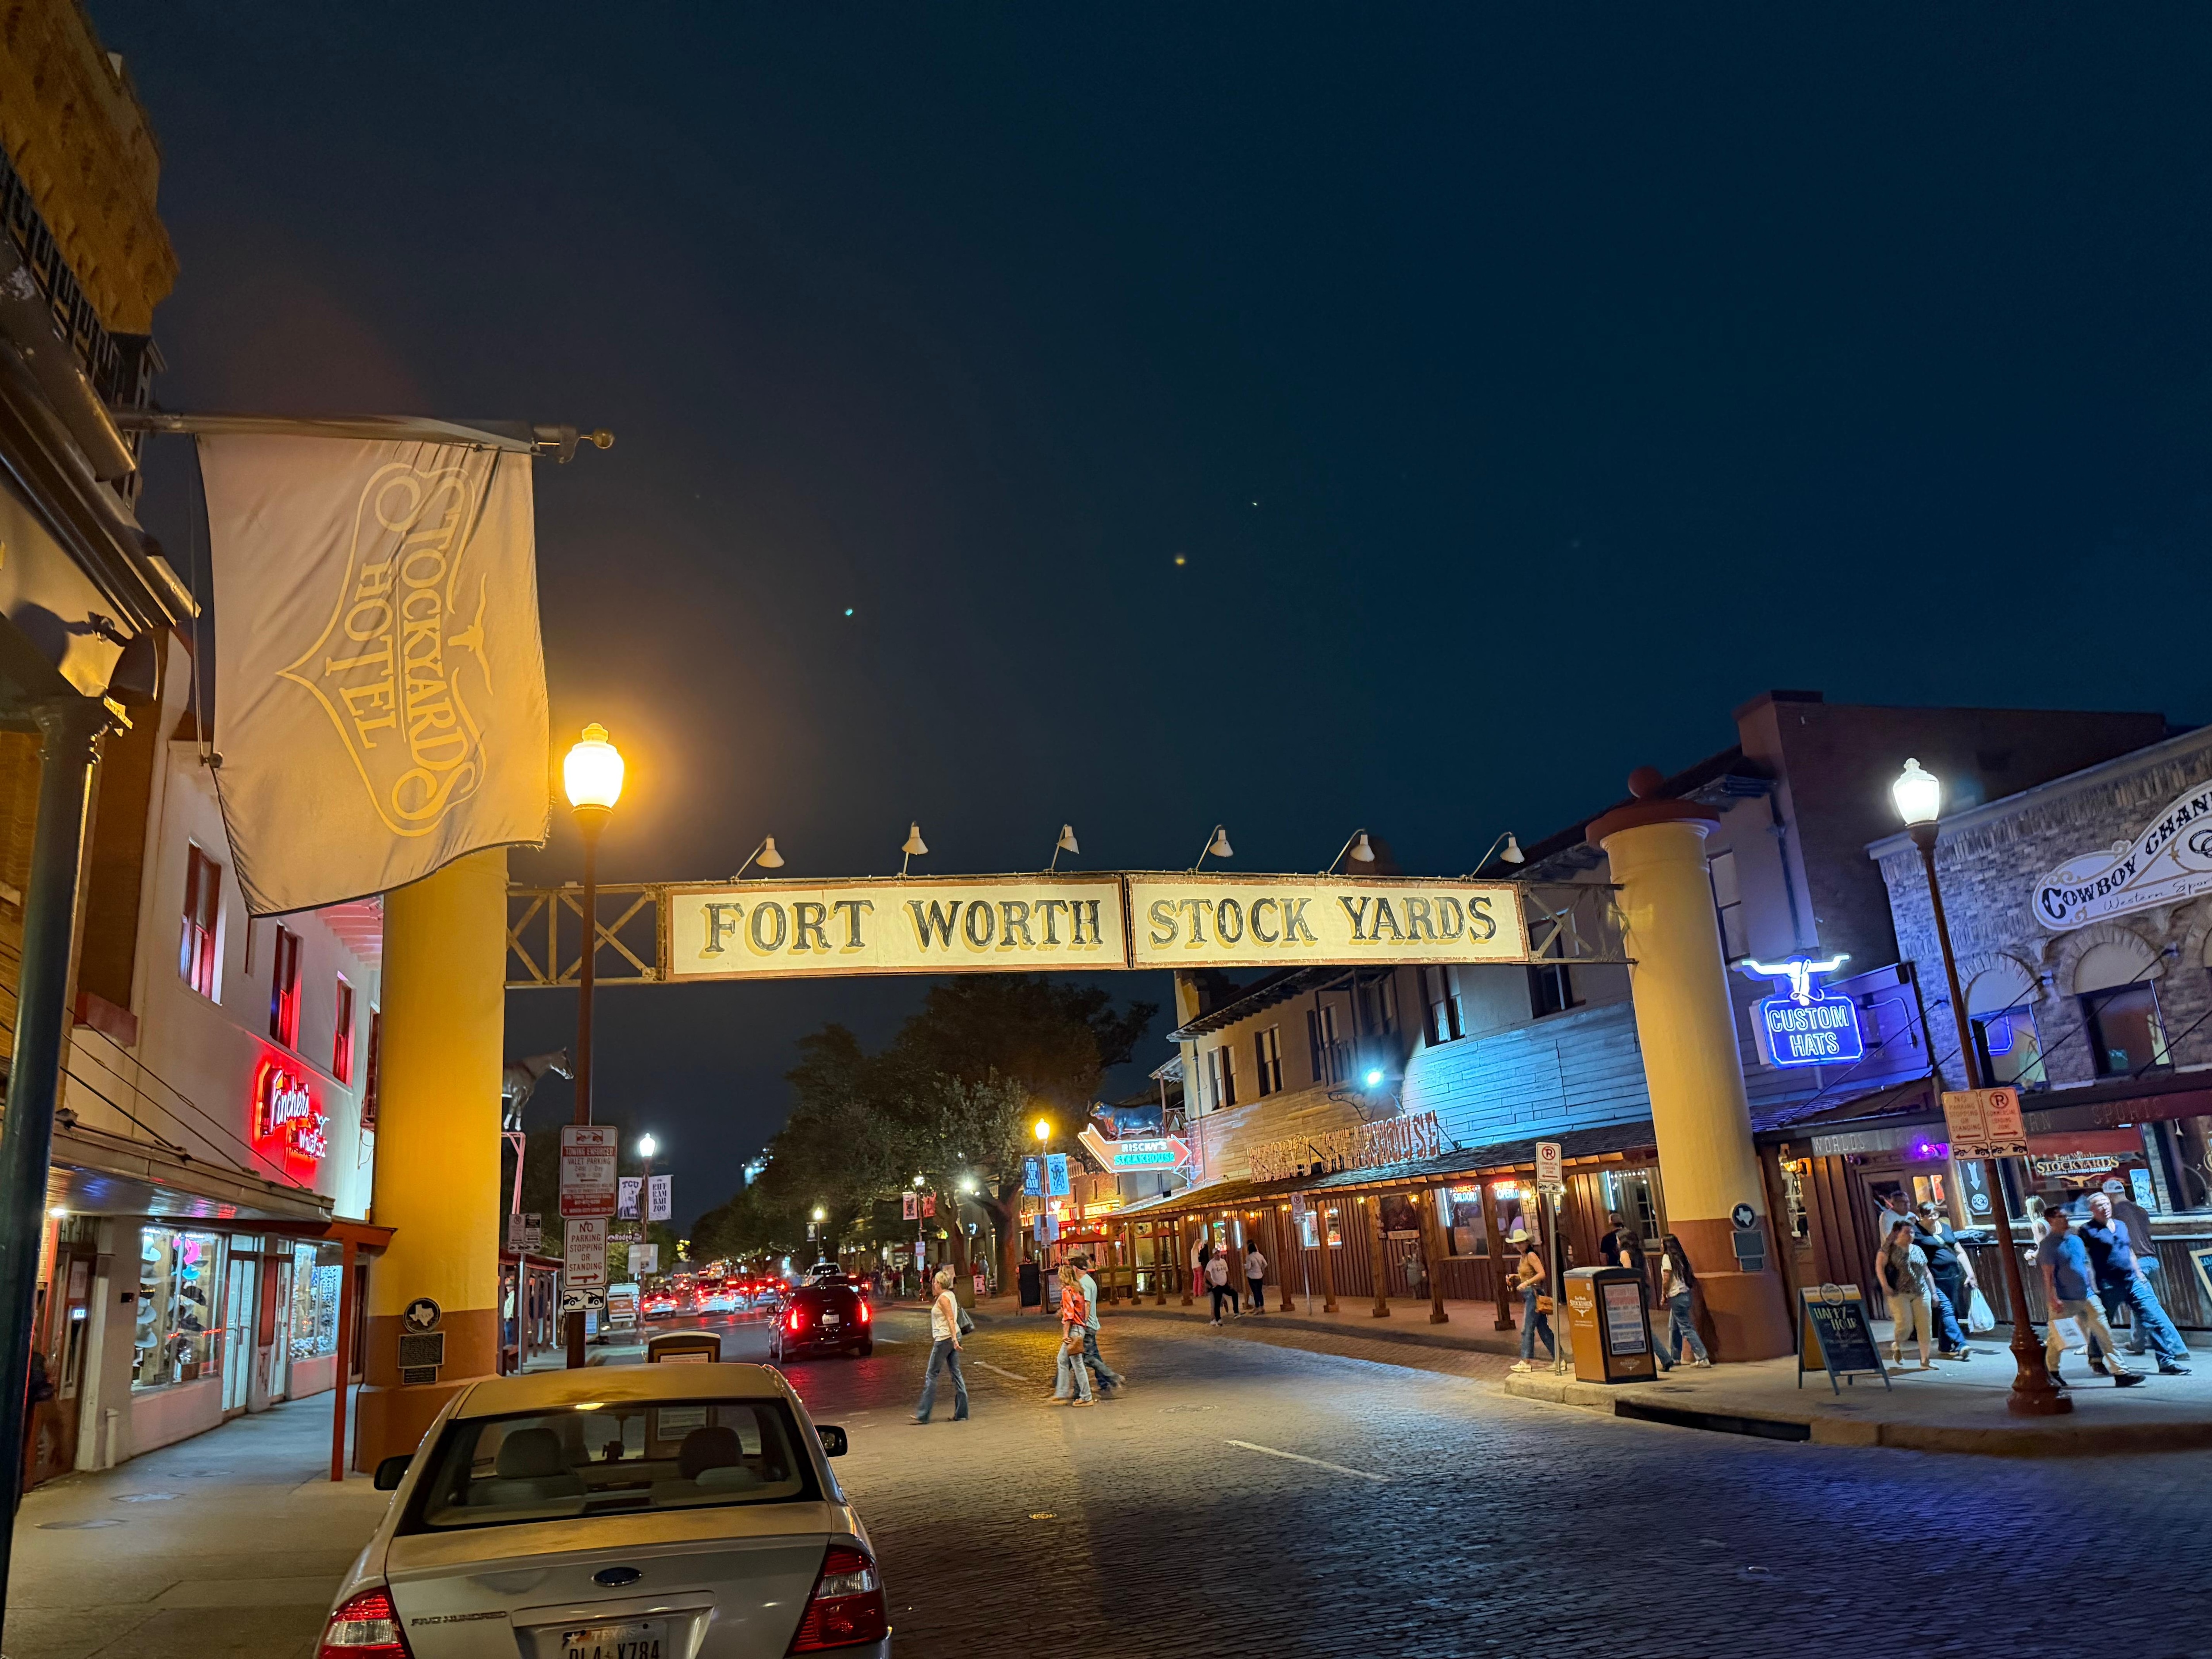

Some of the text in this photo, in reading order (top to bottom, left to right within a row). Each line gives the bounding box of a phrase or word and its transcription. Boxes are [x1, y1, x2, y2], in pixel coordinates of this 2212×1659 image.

[375, 465, 476, 819] STOCKYARDS
[326, 561, 397, 749] HOTEL
[2042, 853, 2136, 919] COWBOY
[2104, 876, 2212, 911] Western Spor
[699, 899, 1104, 959] FORT WORTH
[1148, 896, 1498, 949] STOCK YARDS
[1770, 1005, 1850, 1033] CUSTOM
[1789, 1032, 1840, 1057] HATS
[1814, 1134, 1865, 1153] WORLDS
[1114, 1152, 1175, 1166] STEAKHOUSE
[2037, 1156, 2119, 1173] STOCKYARDS
[580, 1223, 593, 1233] NO
[571, 1234, 601, 1242] PARKING
[614, 1233, 632, 1242] Rodeo
[569, 1244, 603, 1252] STOPPING
[569, 1263, 603, 1271] STANDING
[1814, 1306, 1846, 1319] HAPPY
[1831, 1317, 1857, 1331] HOUR
[411, 1611, 507, 1626] FIVE HUNDRED
[591, 1628, 637, 1641] TEXAS
